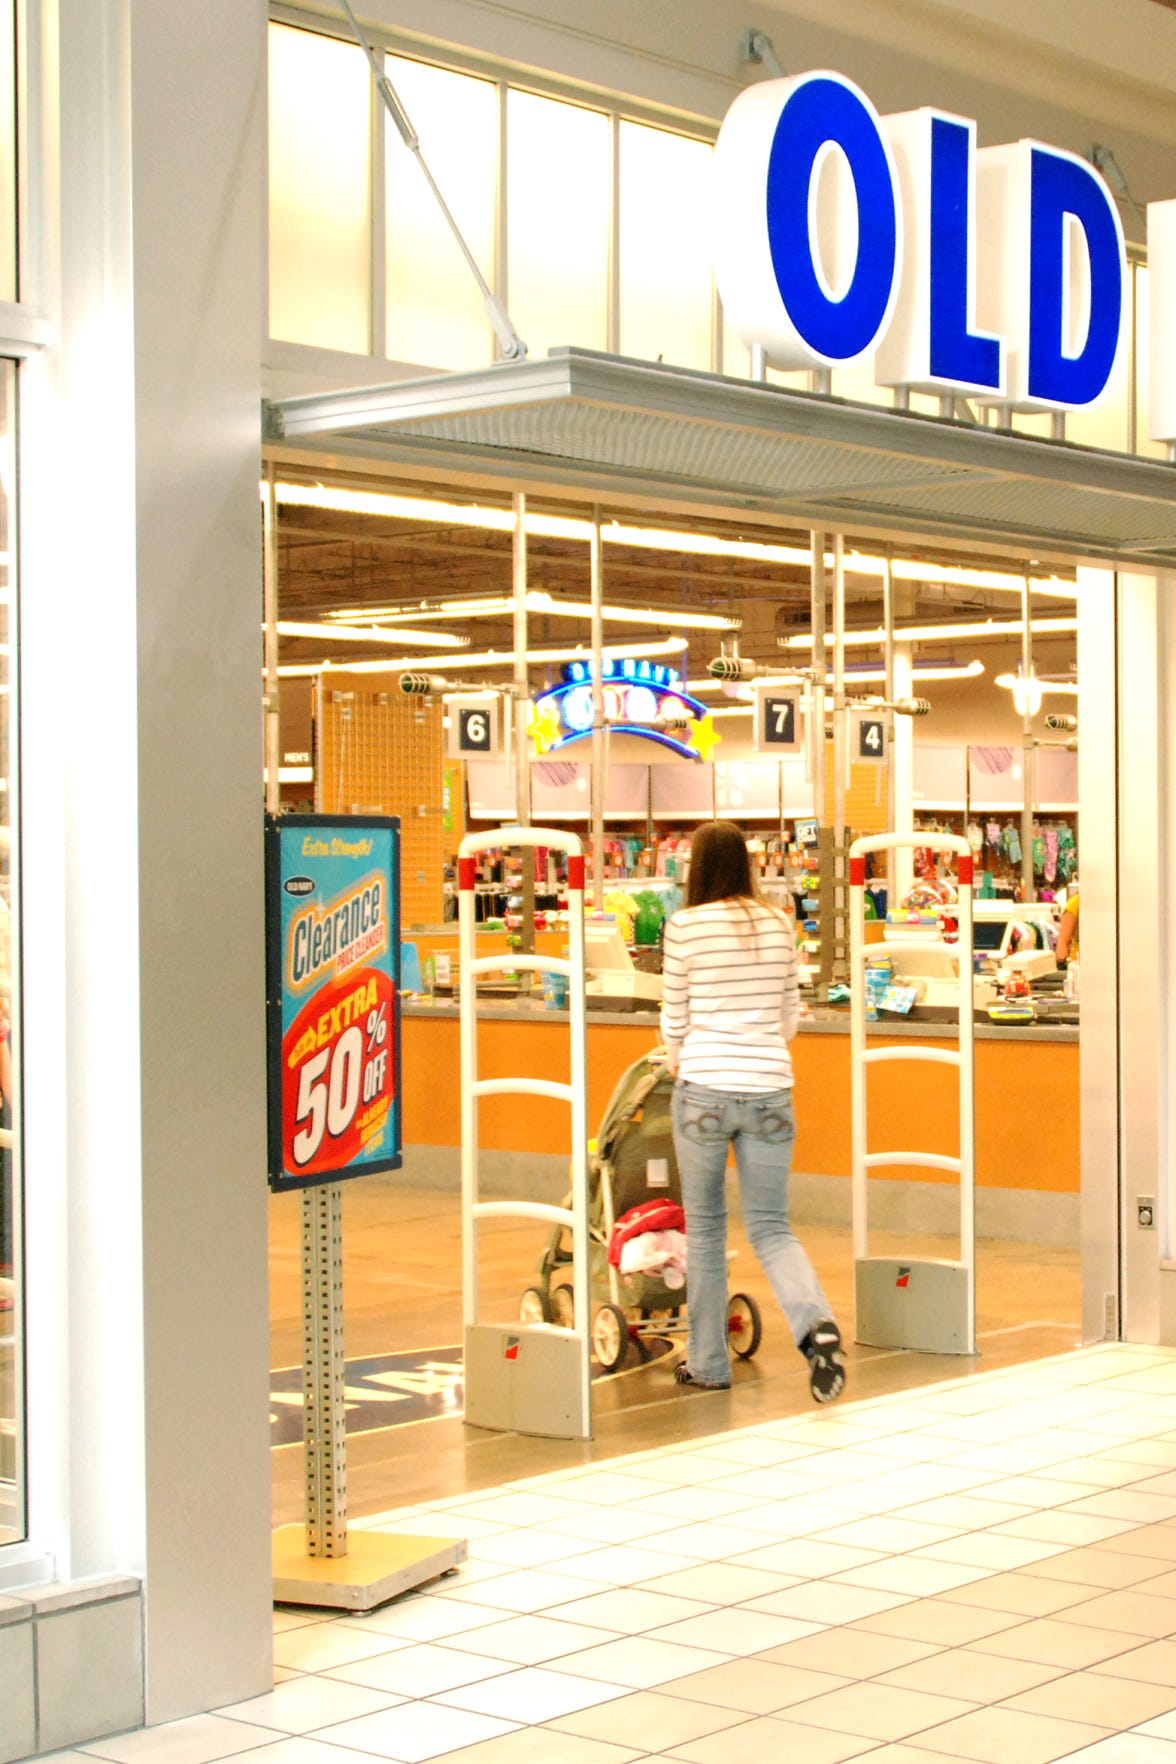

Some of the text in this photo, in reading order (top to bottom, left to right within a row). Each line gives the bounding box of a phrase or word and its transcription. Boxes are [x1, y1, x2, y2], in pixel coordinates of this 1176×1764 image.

[764, 73, 1124, 410] OLD
[466, 714, 486, 742] 6
[771, 705, 788, 734] 7
[865, 725, 880, 749] 4
[293, 882, 381, 982] Clearance
[316, 977, 378, 1047] EXTRA
[363, 1049, 388, 1104] OFF
